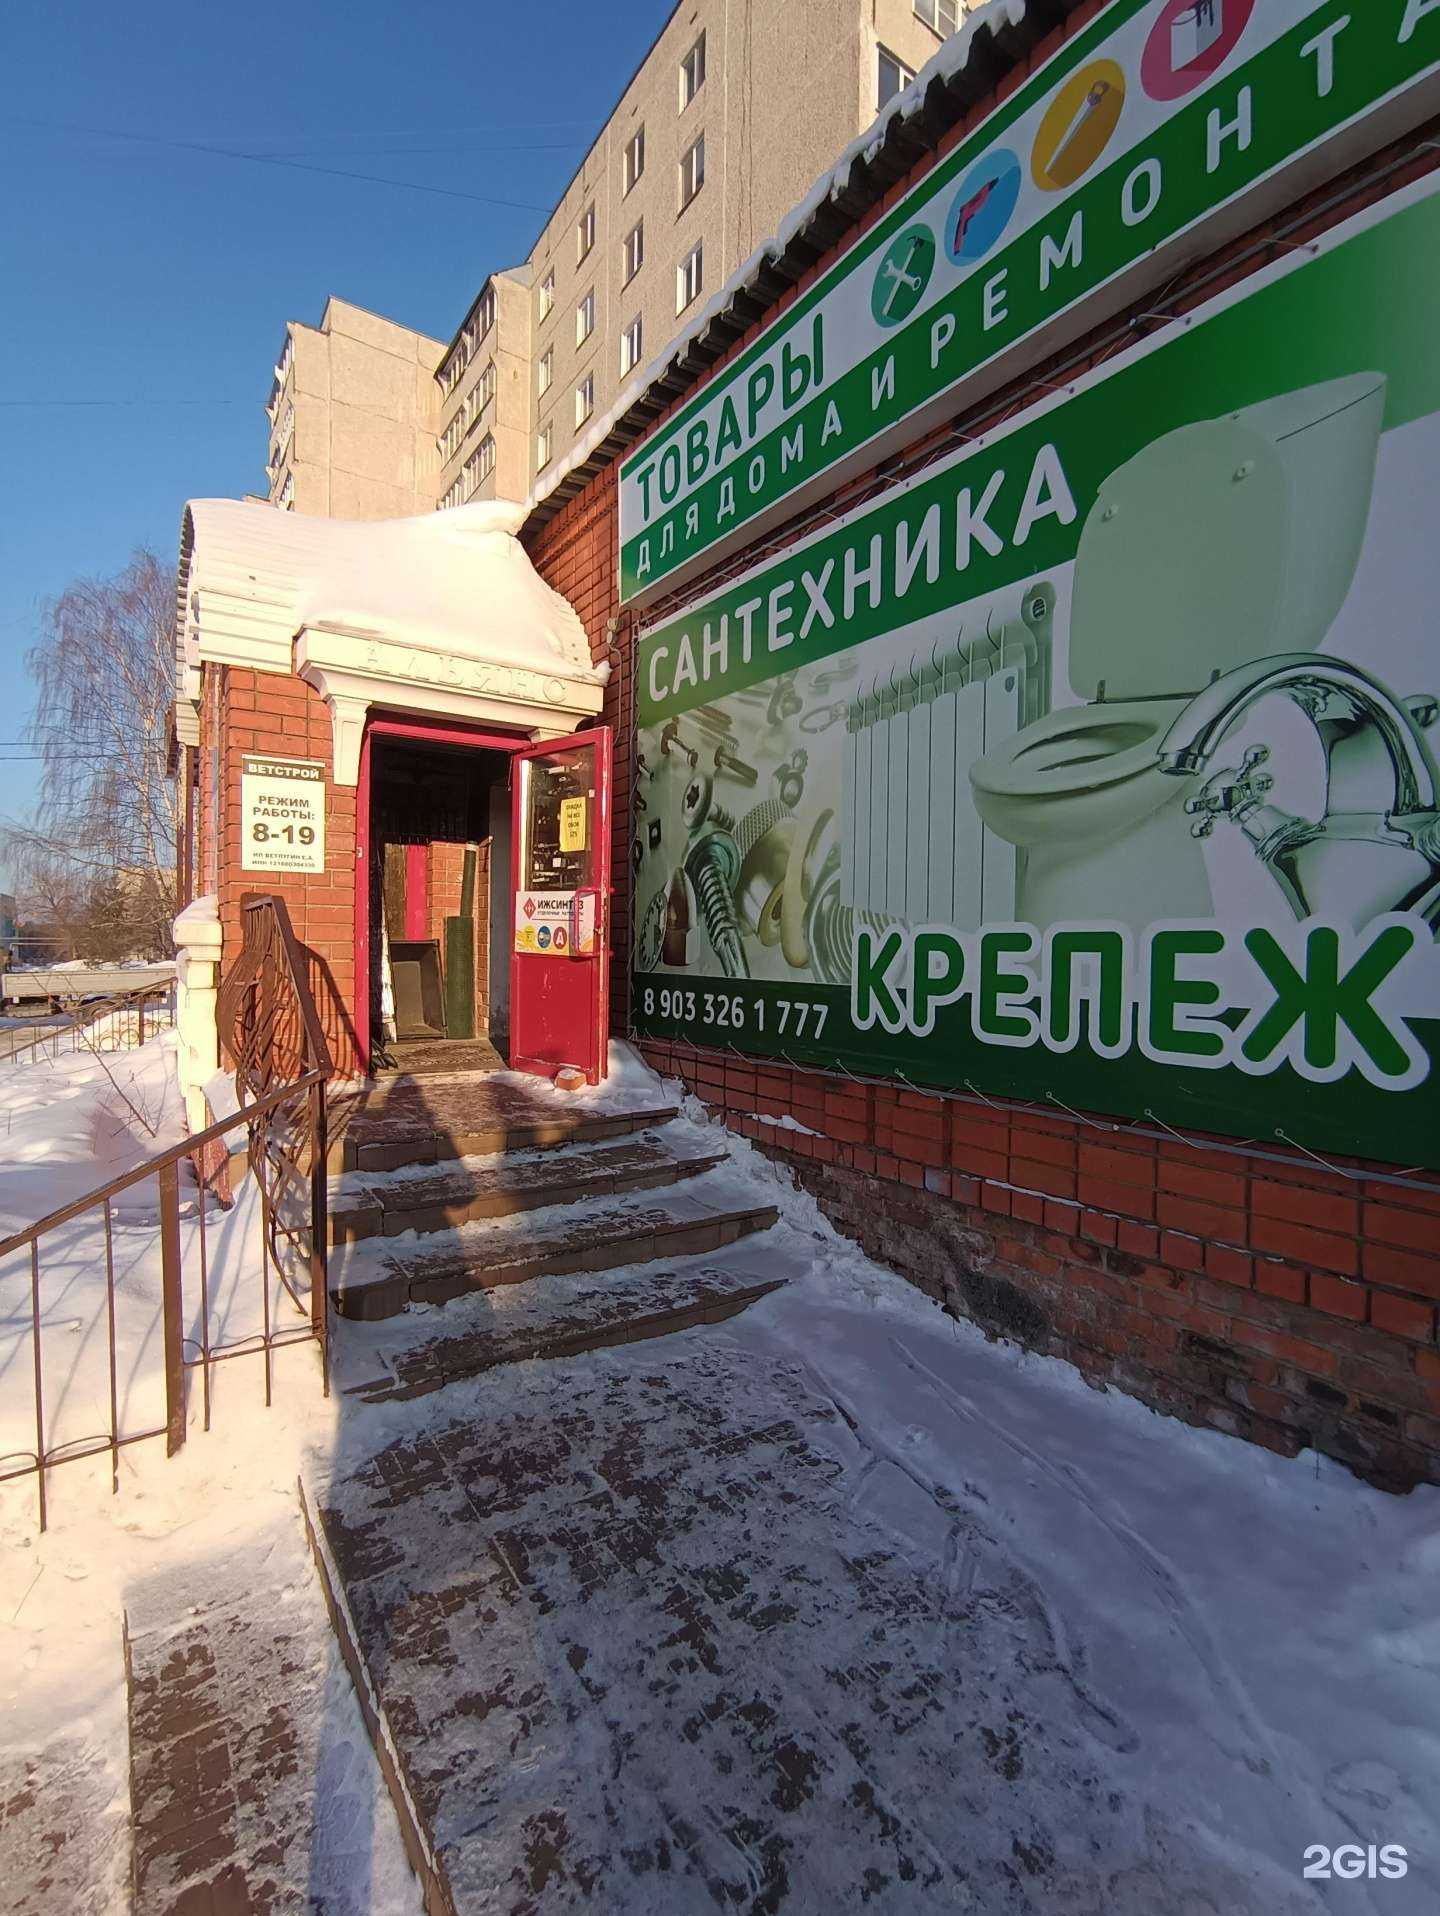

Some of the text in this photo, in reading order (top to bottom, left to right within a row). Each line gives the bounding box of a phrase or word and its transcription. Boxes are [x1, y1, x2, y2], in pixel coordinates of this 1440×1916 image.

[636, 312, 825, 524] ТОВАРЫ
[636, 509, 700, 579] ДЛЯ
[716, 408, 843, 518] ДОМА
[871, 363, 895, 411] И
[648, 442, 1077, 702] САНТЕХНИКА
[248, 763, 320, 780] ВЕТСТРОЙ
[252, 806, 315, 820] РАБОТЫ:
[258, 795, 310, 808] РЕЖИМ
[252, 822, 315, 845] 8-19
[537, 899, 584, 911] ИЖСИНТЗ
[643, 987, 829, 1040] 8 903 326 1 777
[855, 922, 1418, 1079] КРЕПЕЖ
